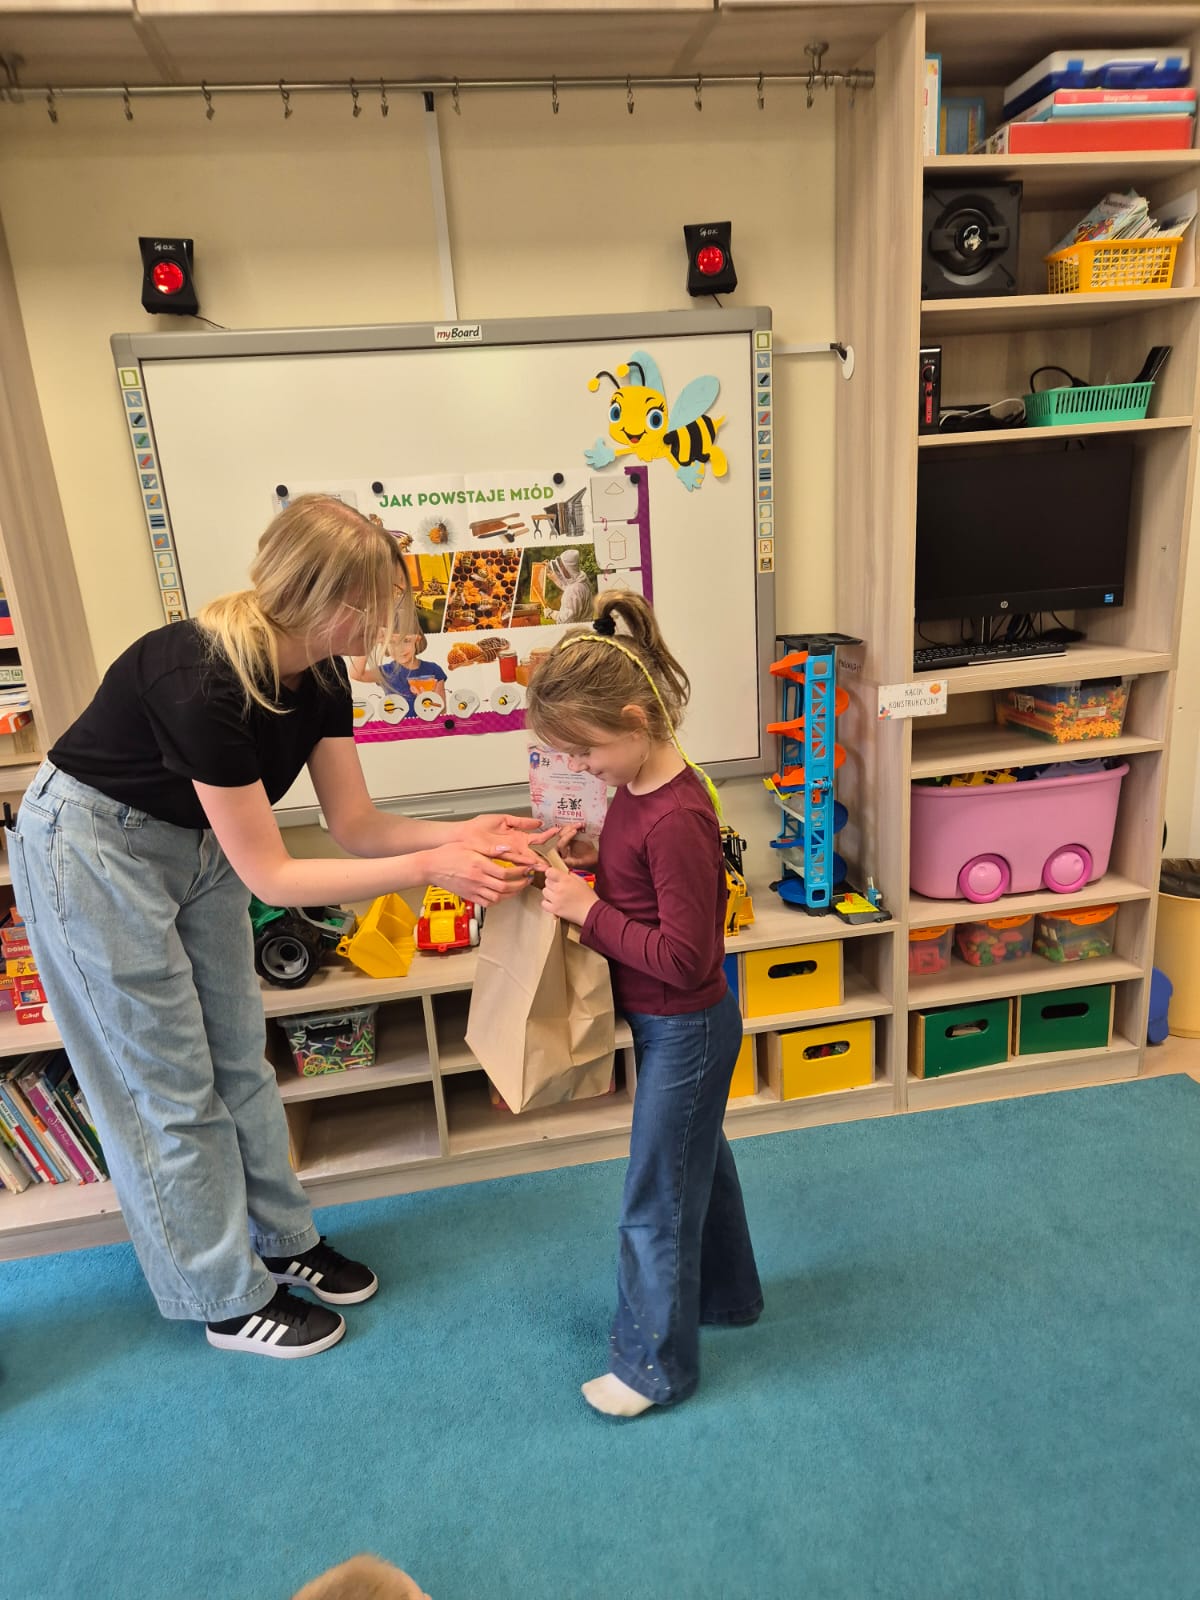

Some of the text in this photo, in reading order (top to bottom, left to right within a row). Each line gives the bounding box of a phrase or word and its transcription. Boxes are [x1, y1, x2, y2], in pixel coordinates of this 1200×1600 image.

[437, 326, 479, 340] myBoard
[379, 484, 554, 508] JAK POWSTAJE MIÓD
